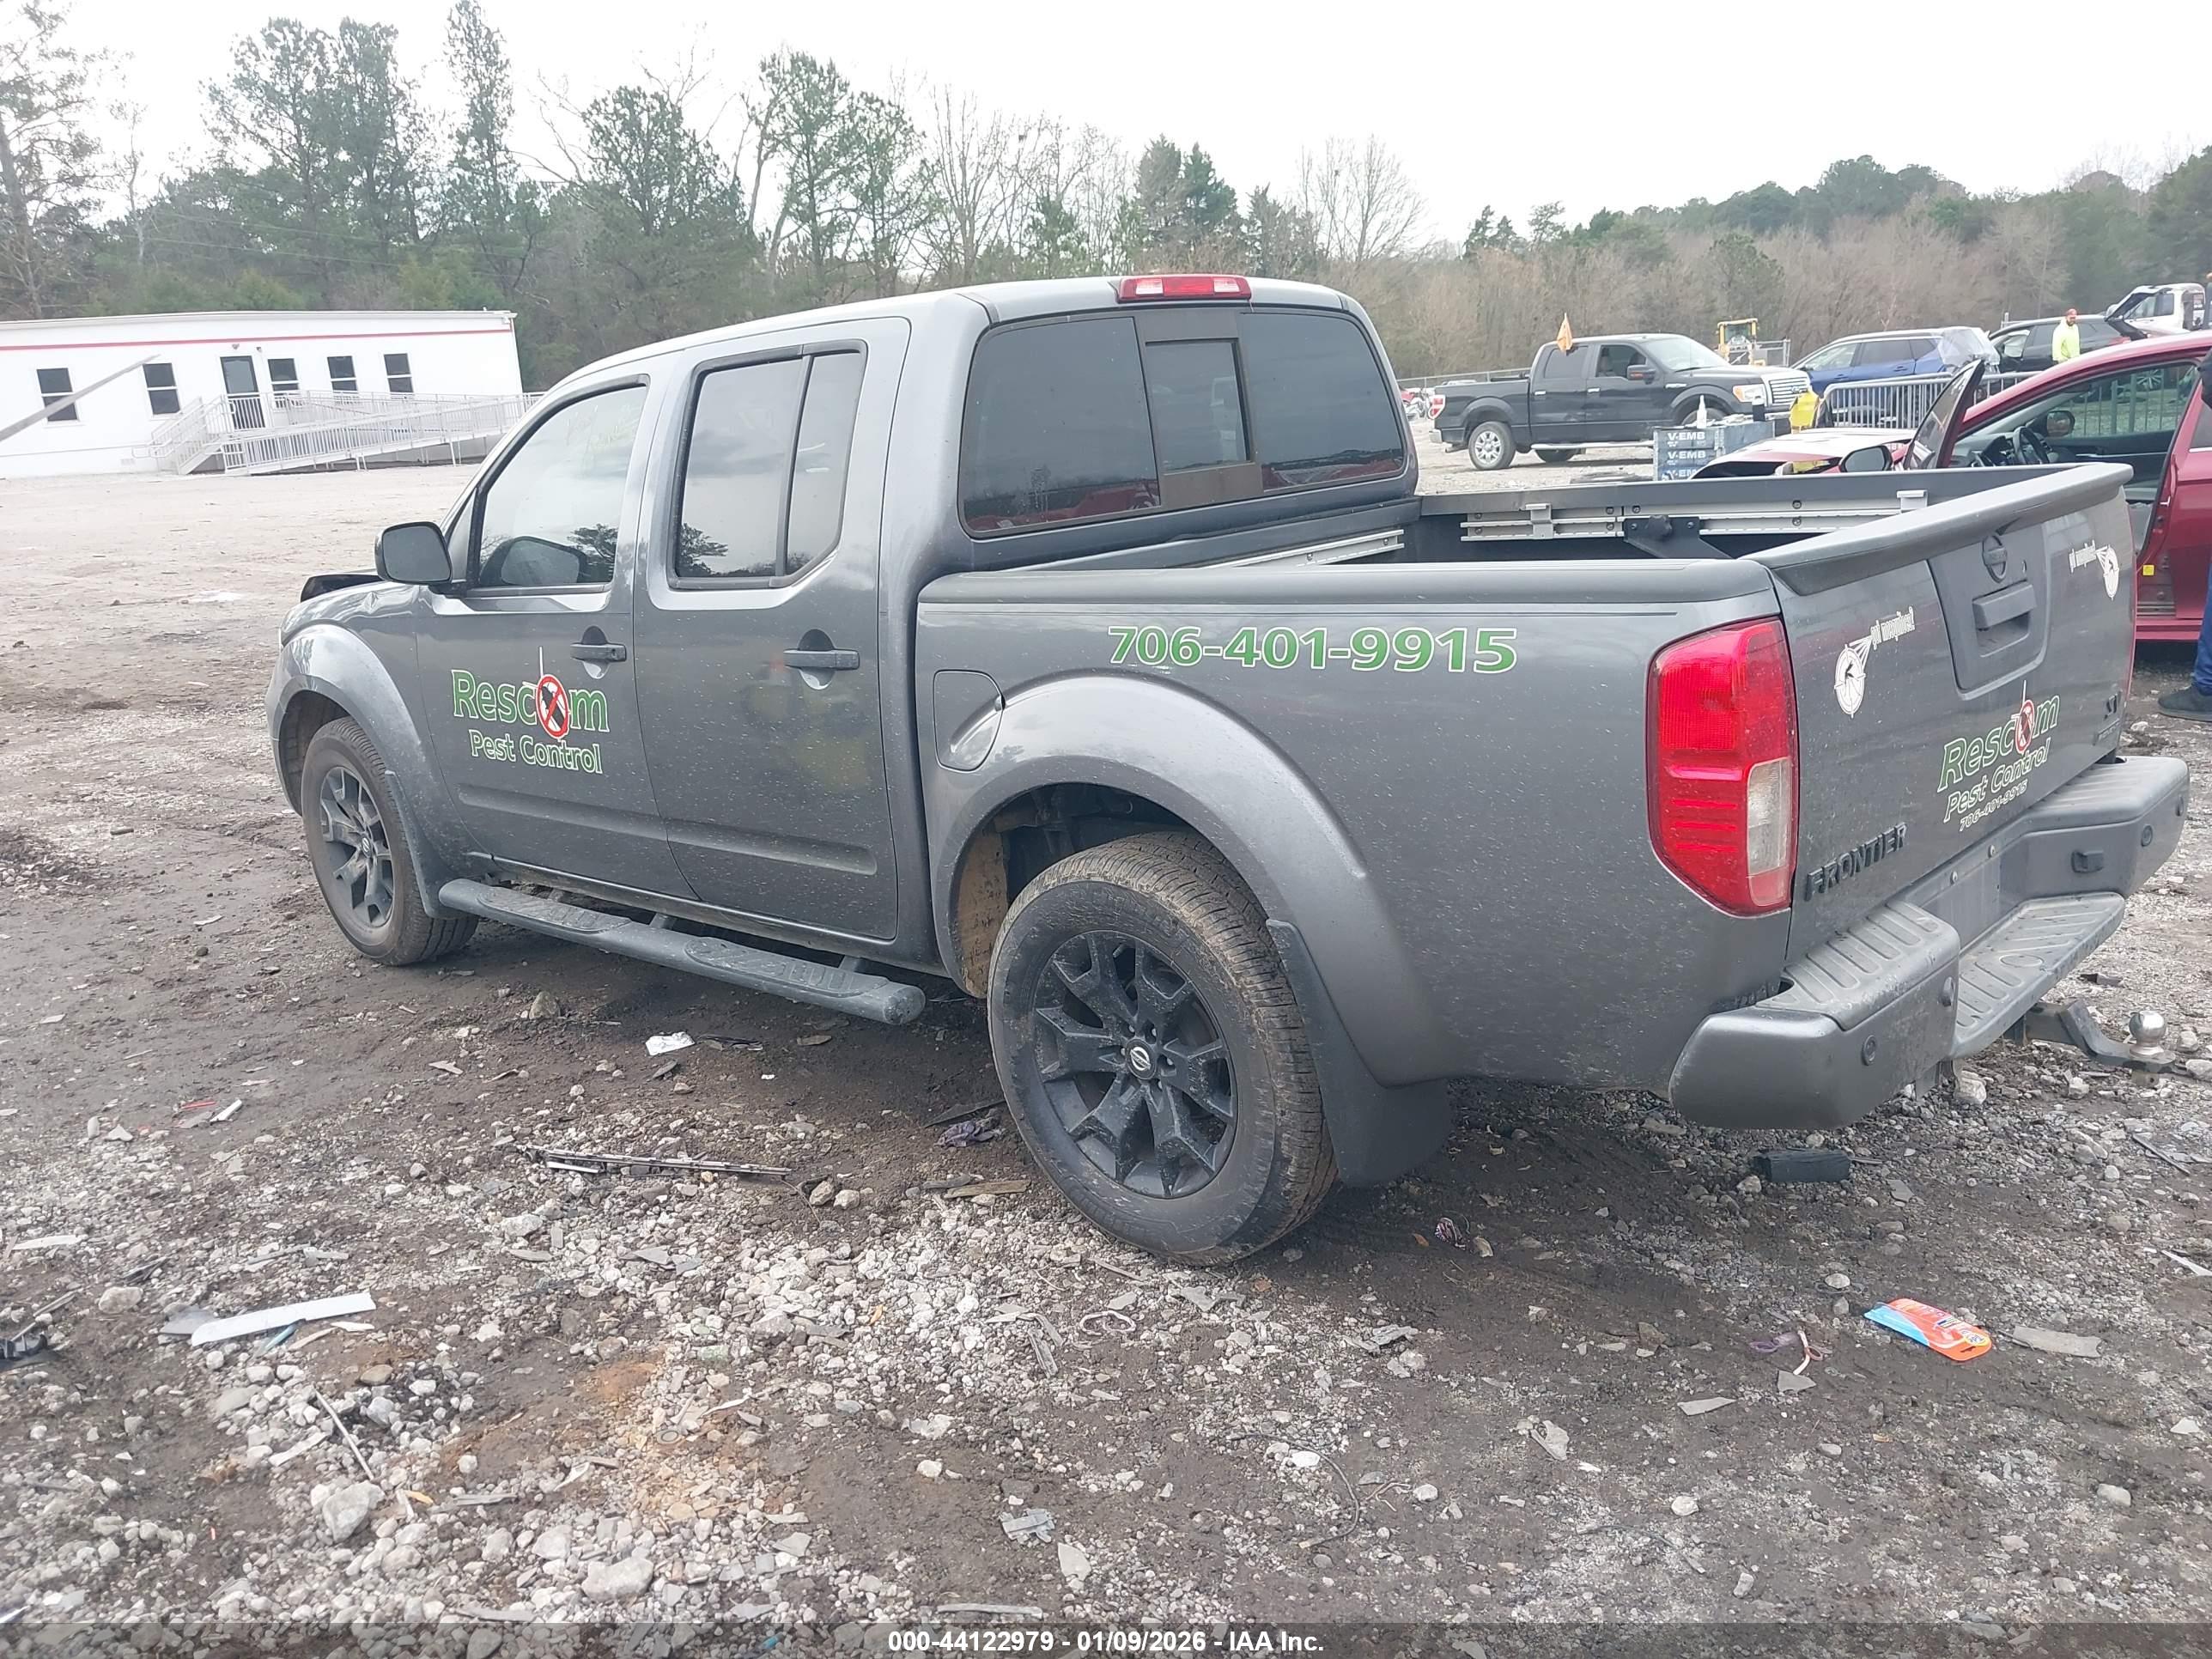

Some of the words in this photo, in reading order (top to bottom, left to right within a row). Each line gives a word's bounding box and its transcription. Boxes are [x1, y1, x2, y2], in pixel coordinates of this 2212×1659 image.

[1108, 625, 1518, 674] 706-401-9915
[468, 728, 516, 763] Pest
[520, 734, 603, 775] Control
[1943, 775, 1988, 823] Pest
[1990, 737, 2051, 793] Control
[1959, 779, 2028, 832] 706-401-9915
[1803, 822, 1907, 902] FRONTIER
